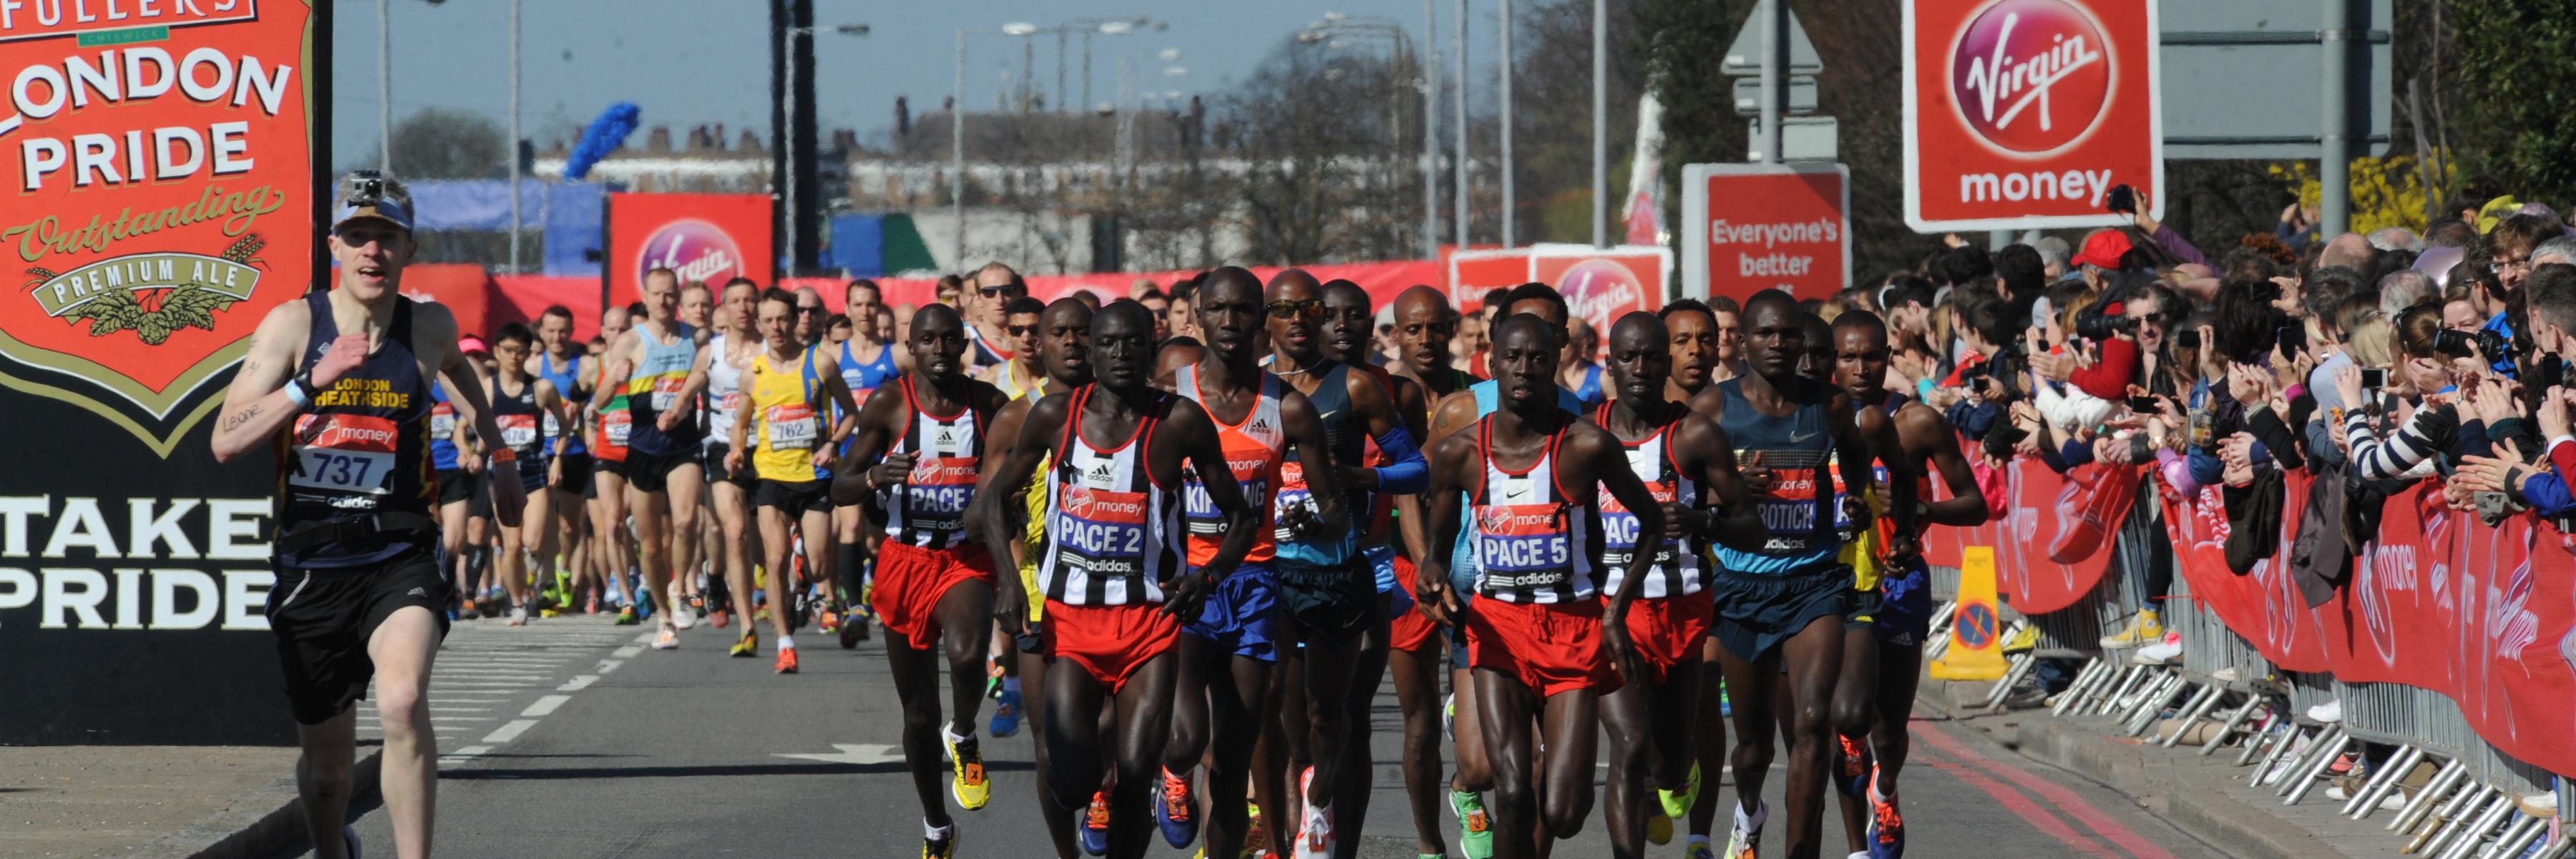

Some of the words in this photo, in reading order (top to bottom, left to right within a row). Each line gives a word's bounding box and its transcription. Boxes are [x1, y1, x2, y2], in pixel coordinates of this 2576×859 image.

[87, 31, 158, 43] CHISWICK
[1966, 11, 2099, 131] Virgin
[0, 47, 292, 134] ONDON
[20, 121, 255, 192] PRIDE
[1961, 169, 2112, 208] money
[2, 185, 285, 261] Outstanding
[1712, 217, 1838, 249] Everyone's
[650, 233, 732, 285] Vrgin
[1740, 252, 1813, 277] better
[54, 260, 173, 304] PREMIUM
[191, 260, 238, 288] ALE
[315, 391, 409, 408] HEATHSIDE
[335, 378, 390, 392] LONDON
[341, 427, 394, 445] money
[776, 423, 805, 438] 762
[313, 453, 372, 486] 737
[914, 458, 942, 484] Virgin
[946, 466, 975, 476] mone
[1771, 478, 1813, 491] money
[910, 488, 966, 512] PACE
[1065, 487, 1092, 516] Virgin
[1097, 501, 1142, 516] money
[0, 494, 273, 559] TAKE
[1061, 515, 1119, 552] PACE
[1124, 528, 1141, 552] 2
[1517, 514, 1553, 526] mone
[1086, 559, 1131, 572] adidas
[1485, 538, 1545, 567] PACE
[1551, 537, 1567, 564] 5
[1516, 572, 1563, 585] adidas
[0, 568, 278, 630] PRIDE
